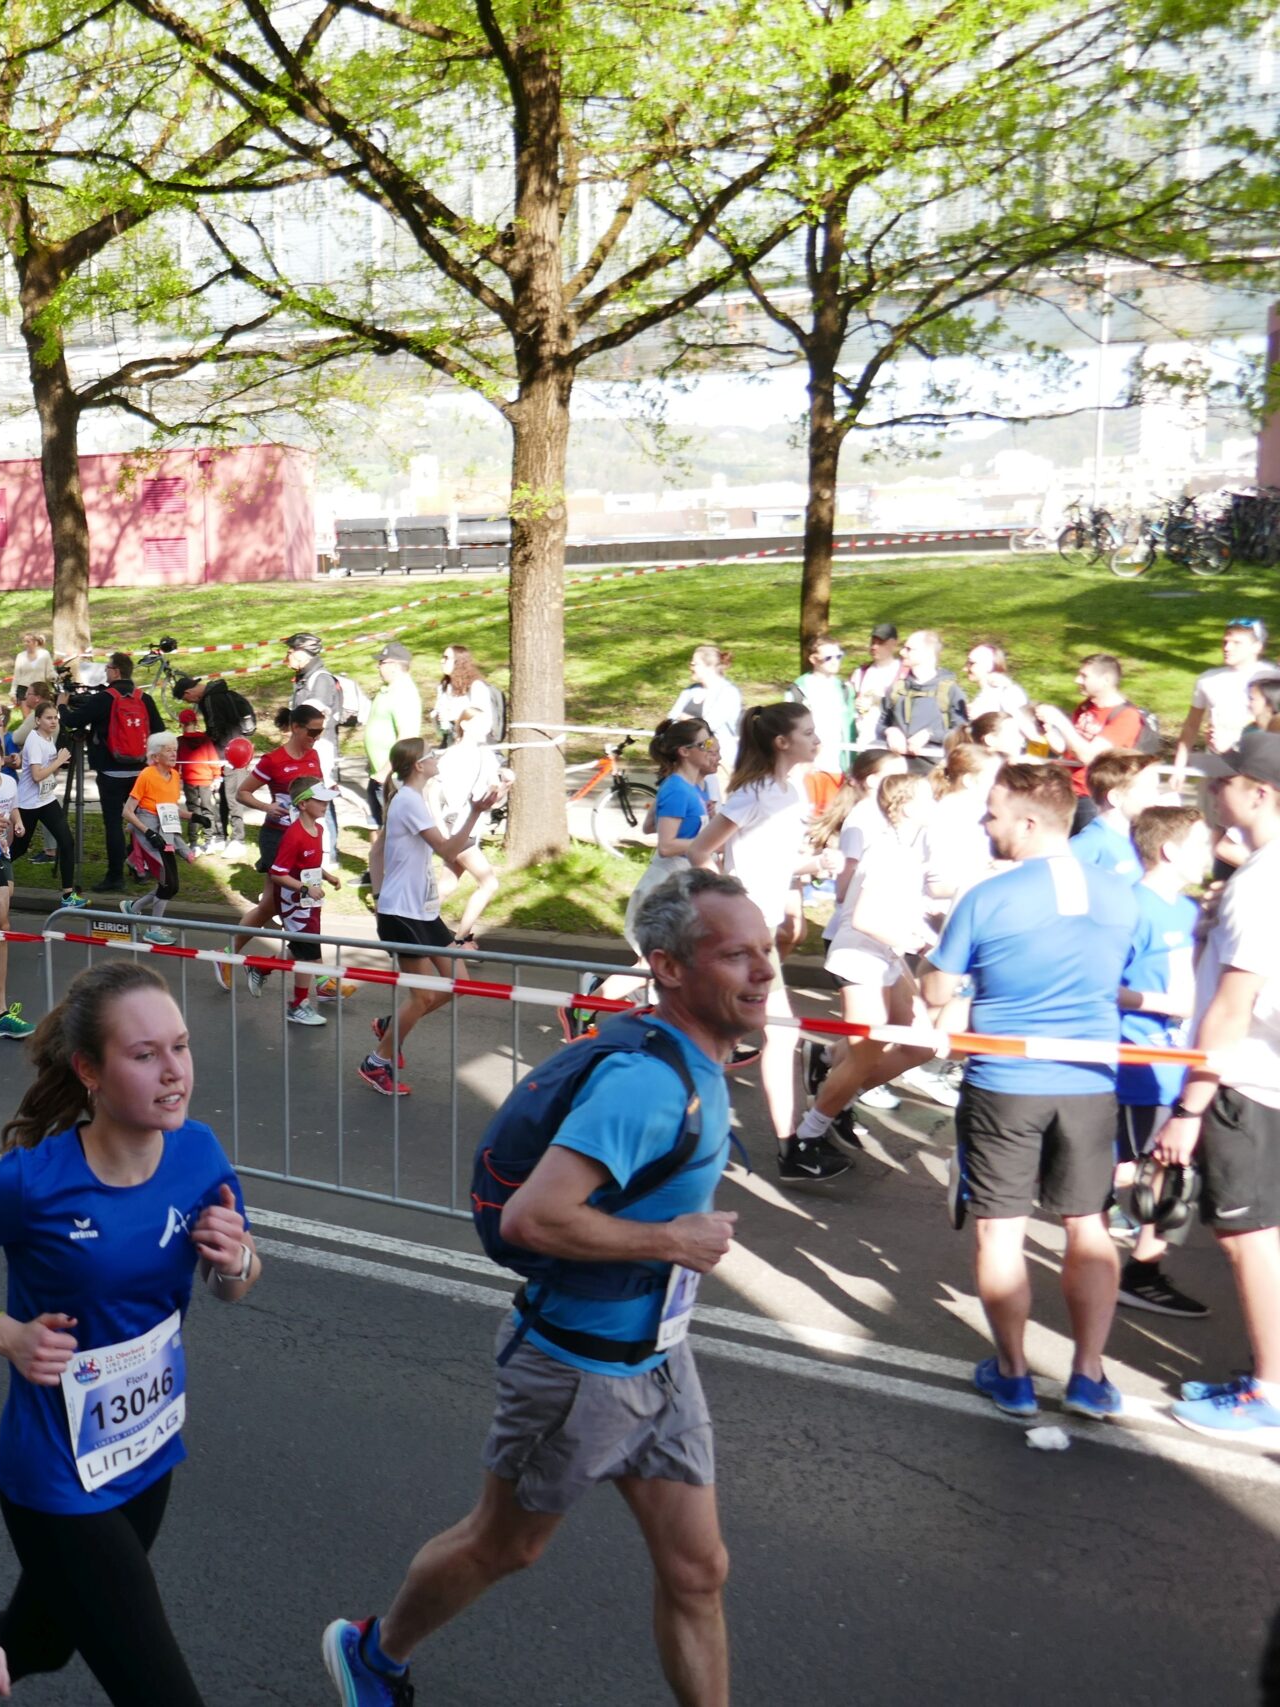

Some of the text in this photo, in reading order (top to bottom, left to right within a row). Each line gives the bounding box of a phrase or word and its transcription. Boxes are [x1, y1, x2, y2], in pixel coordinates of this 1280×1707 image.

[93, 921, 129, 933] LEIRICH
[69, 1229, 99, 1240] erima
[125, 1370, 149, 1387] Flora
[89, 1367, 174, 1431] 13046
[86, 1409, 180, 1479] LINZ AG
